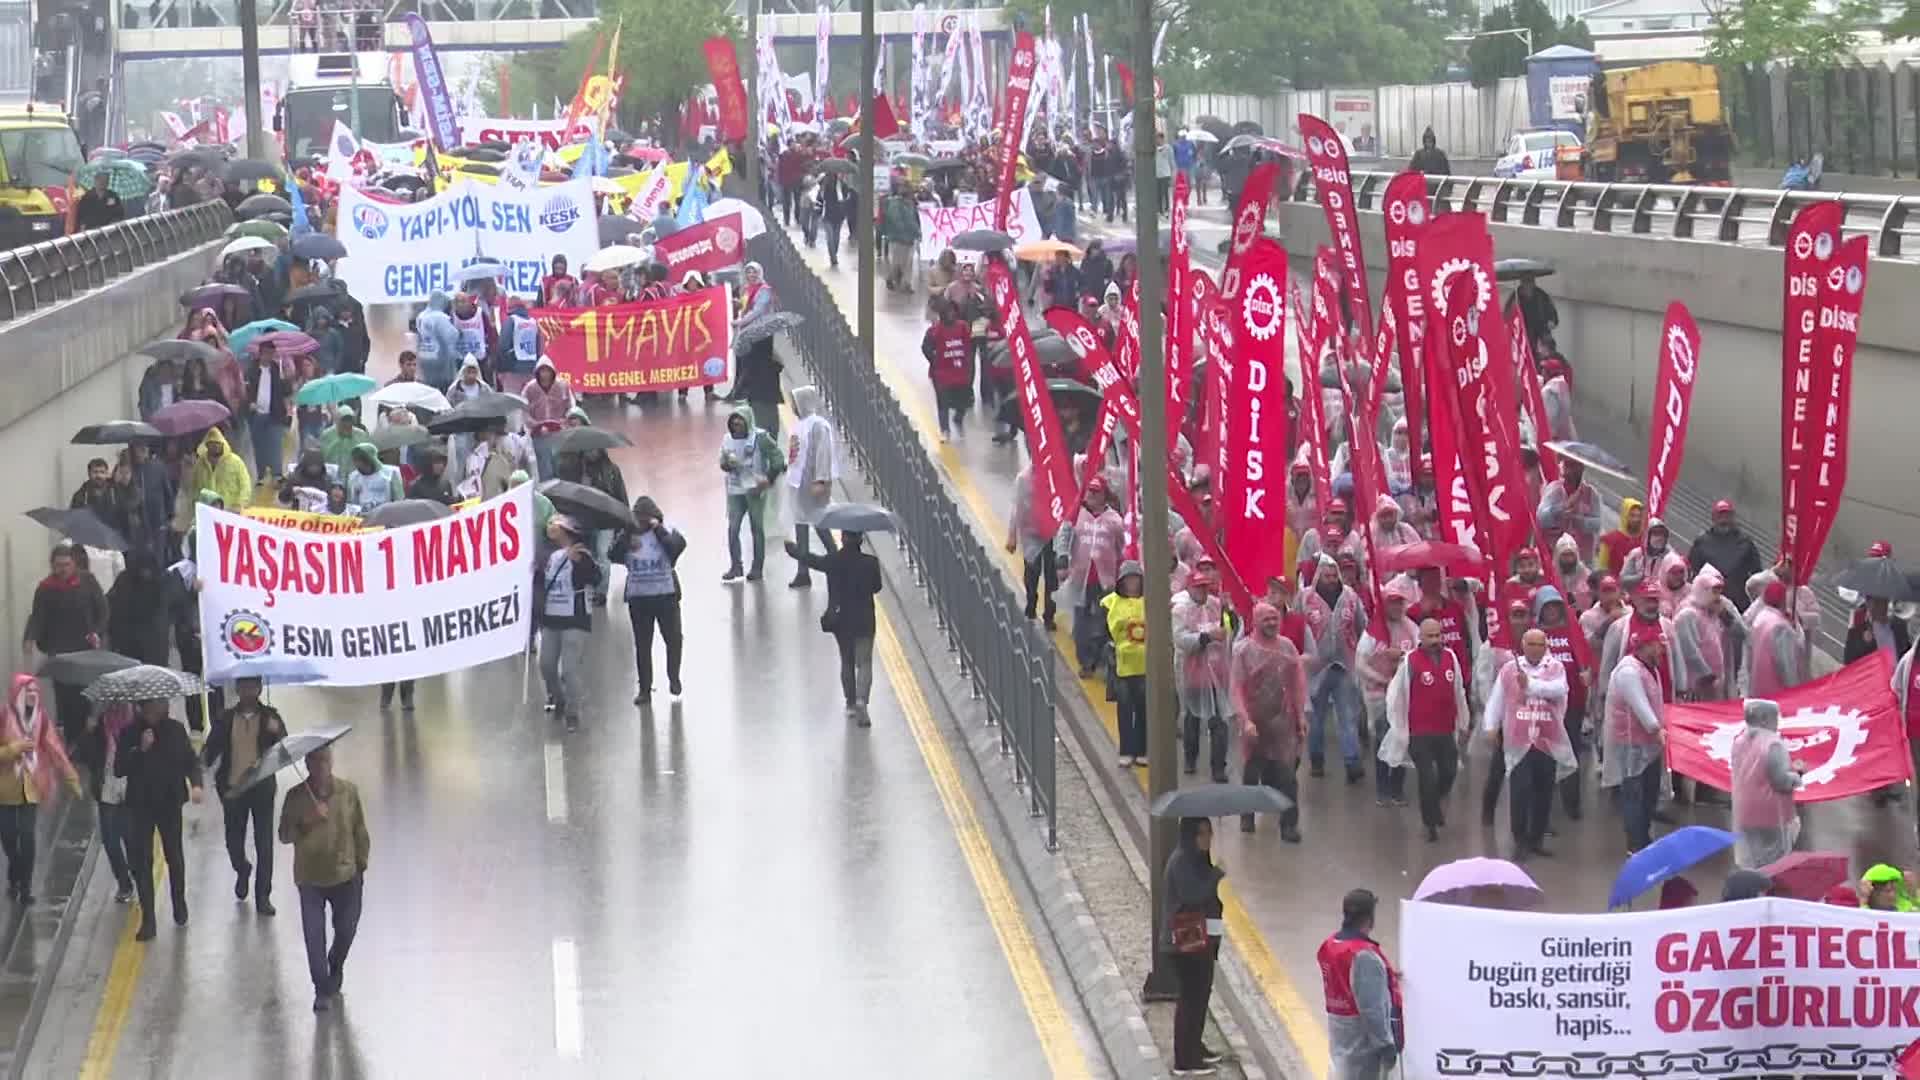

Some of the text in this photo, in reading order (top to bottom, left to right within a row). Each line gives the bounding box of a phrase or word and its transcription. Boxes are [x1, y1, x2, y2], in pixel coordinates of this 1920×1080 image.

[492, 200, 532, 233] SEN
[538, 206, 581, 226] KESK
[1391, 236, 1416, 257] DİS
[384, 261, 454, 297] GENEL
[1789, 271, 1818, 297] DİS
[570, 310, 600, 363] 1
[583, 372, 607, 388] SEN
[608, 370, 647, 386] GENEL
[649, 362, 699, 385] MERKEZİ
[1243, 359, 1267, 520] DİSK
[214, 501, 520, 608] YAŞASIN 1 MAYIS
[282, 585, 520, 659] ESM GENEL MERKEZİ
[1541, 936, 1632, 958] Günlerin
[1655, 921, 1920, 973] GAZETECİL
[1468, 959, 1632, 987] bugün getirdiği
[1489, 986, 1631, 1010] baskı, sansür,
[1655, 975, 1920, 1033] ÖZGÜRLÜK
[1556, 1013, 1632, 1041] hapis...
